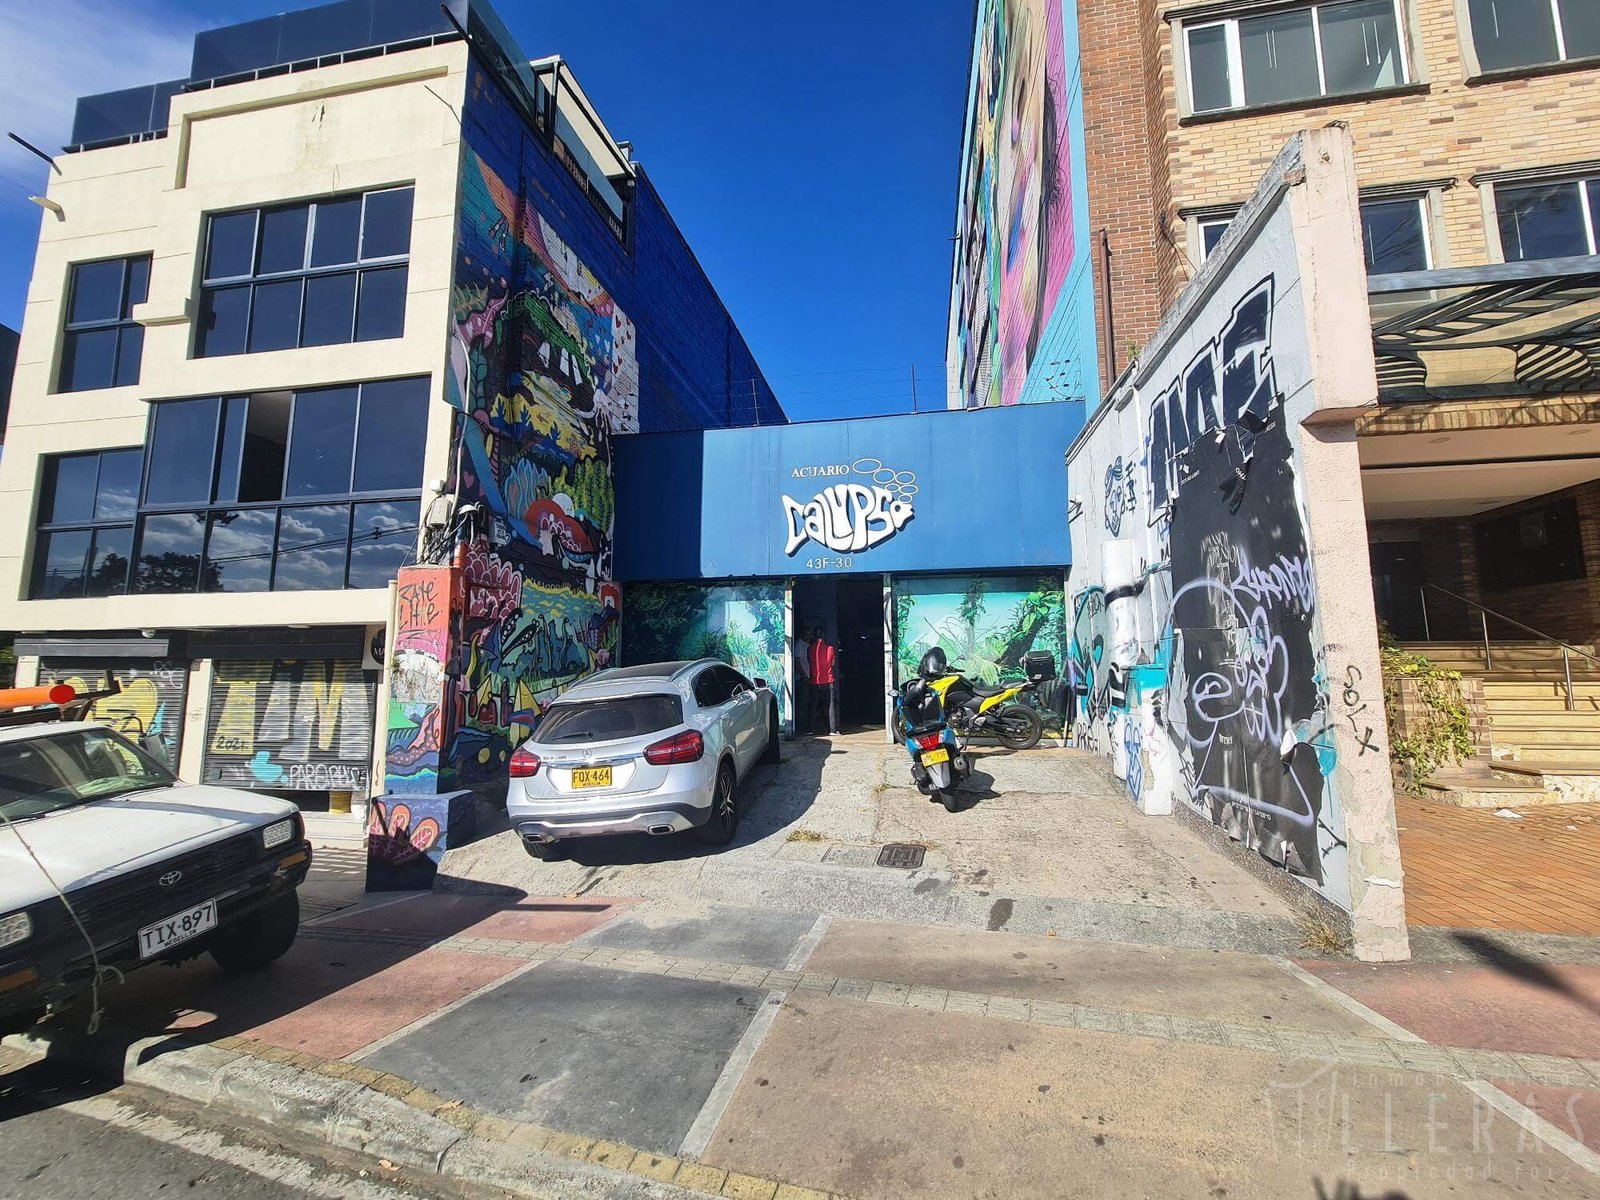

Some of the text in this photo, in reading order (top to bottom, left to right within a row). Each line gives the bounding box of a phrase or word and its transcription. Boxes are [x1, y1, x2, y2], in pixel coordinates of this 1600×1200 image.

[791, 465, 850, 478] ACUARIO
[781, 484, 915, 558] CALYPSO
[805, 556, 852, 569] 43F-30
